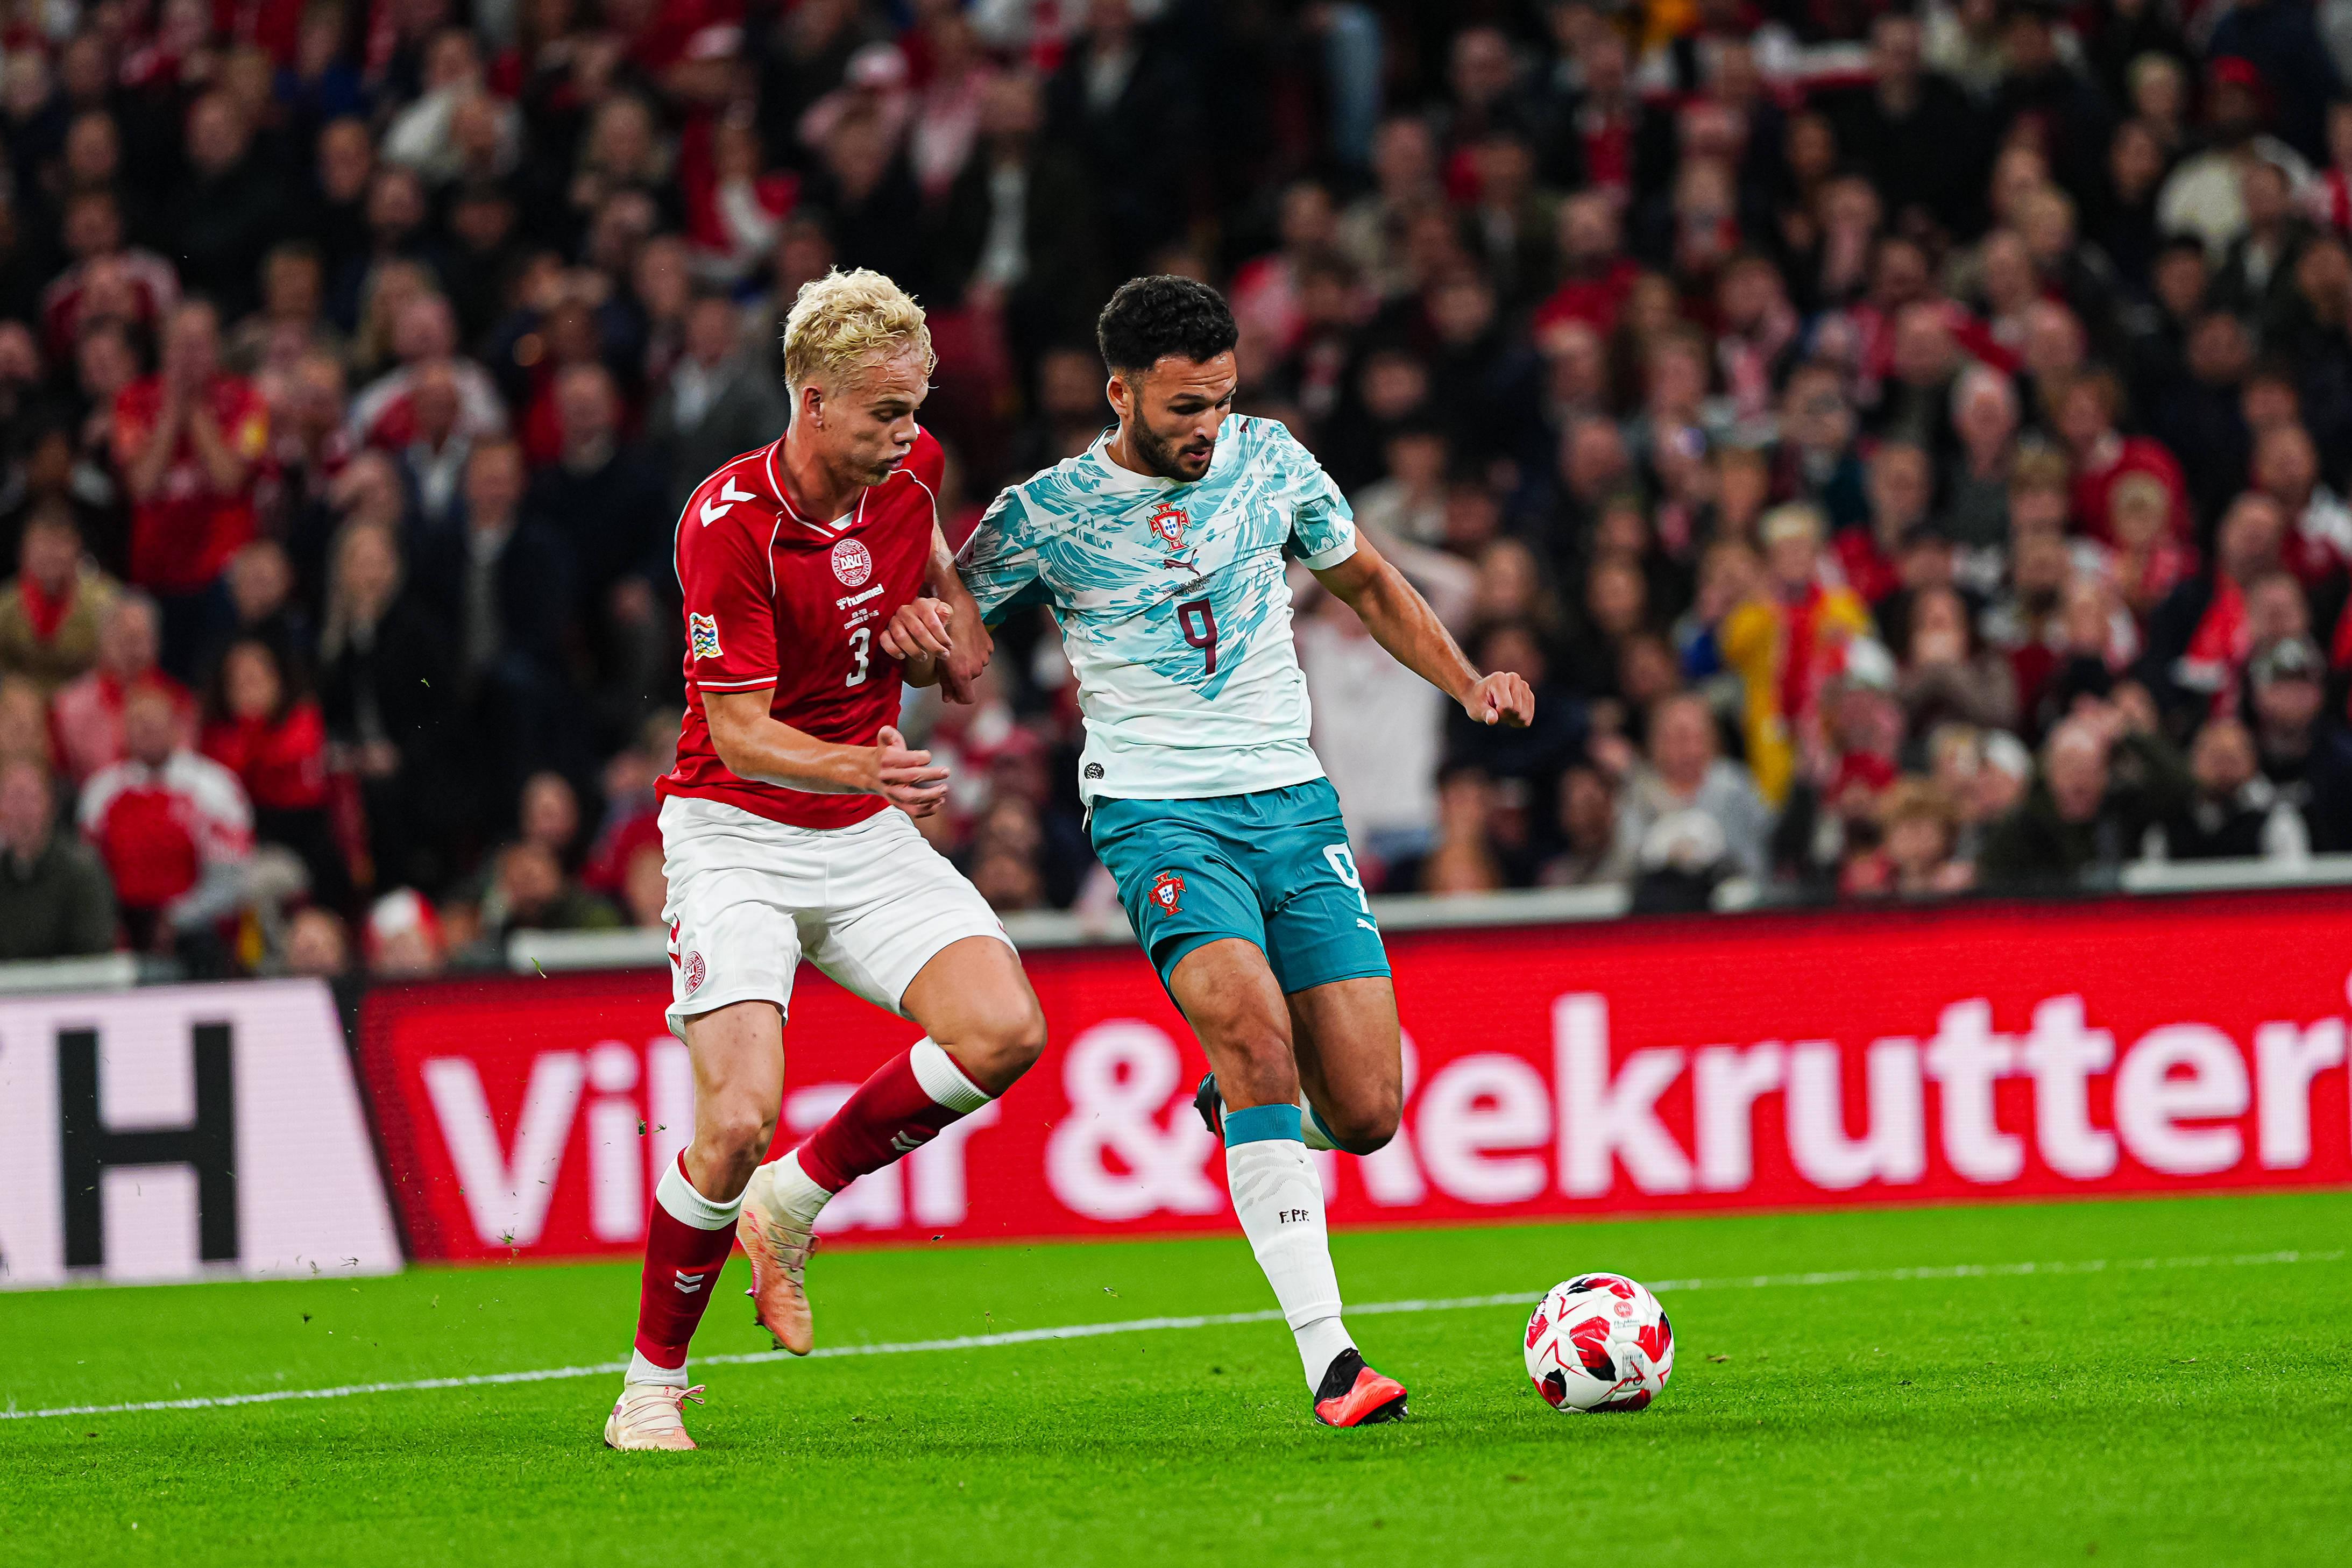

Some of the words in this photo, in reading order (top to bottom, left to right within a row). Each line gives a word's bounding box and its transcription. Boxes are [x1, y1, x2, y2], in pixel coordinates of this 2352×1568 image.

[839, 554, 863, 571] DBU
[846, 584, 885, 607] hummel
[845, 627, 871, 687] 3
[1177, 597, 1217, 676] 9
[1322, 842, 1370, 914] 9
[1045, 1018, 1229, 1222] &
[1307, 971, 2352, 1208] ekrutter
[0, 1018, 240, 1268] H
[1279, 1209, 1309, 1224] F.P.F.
